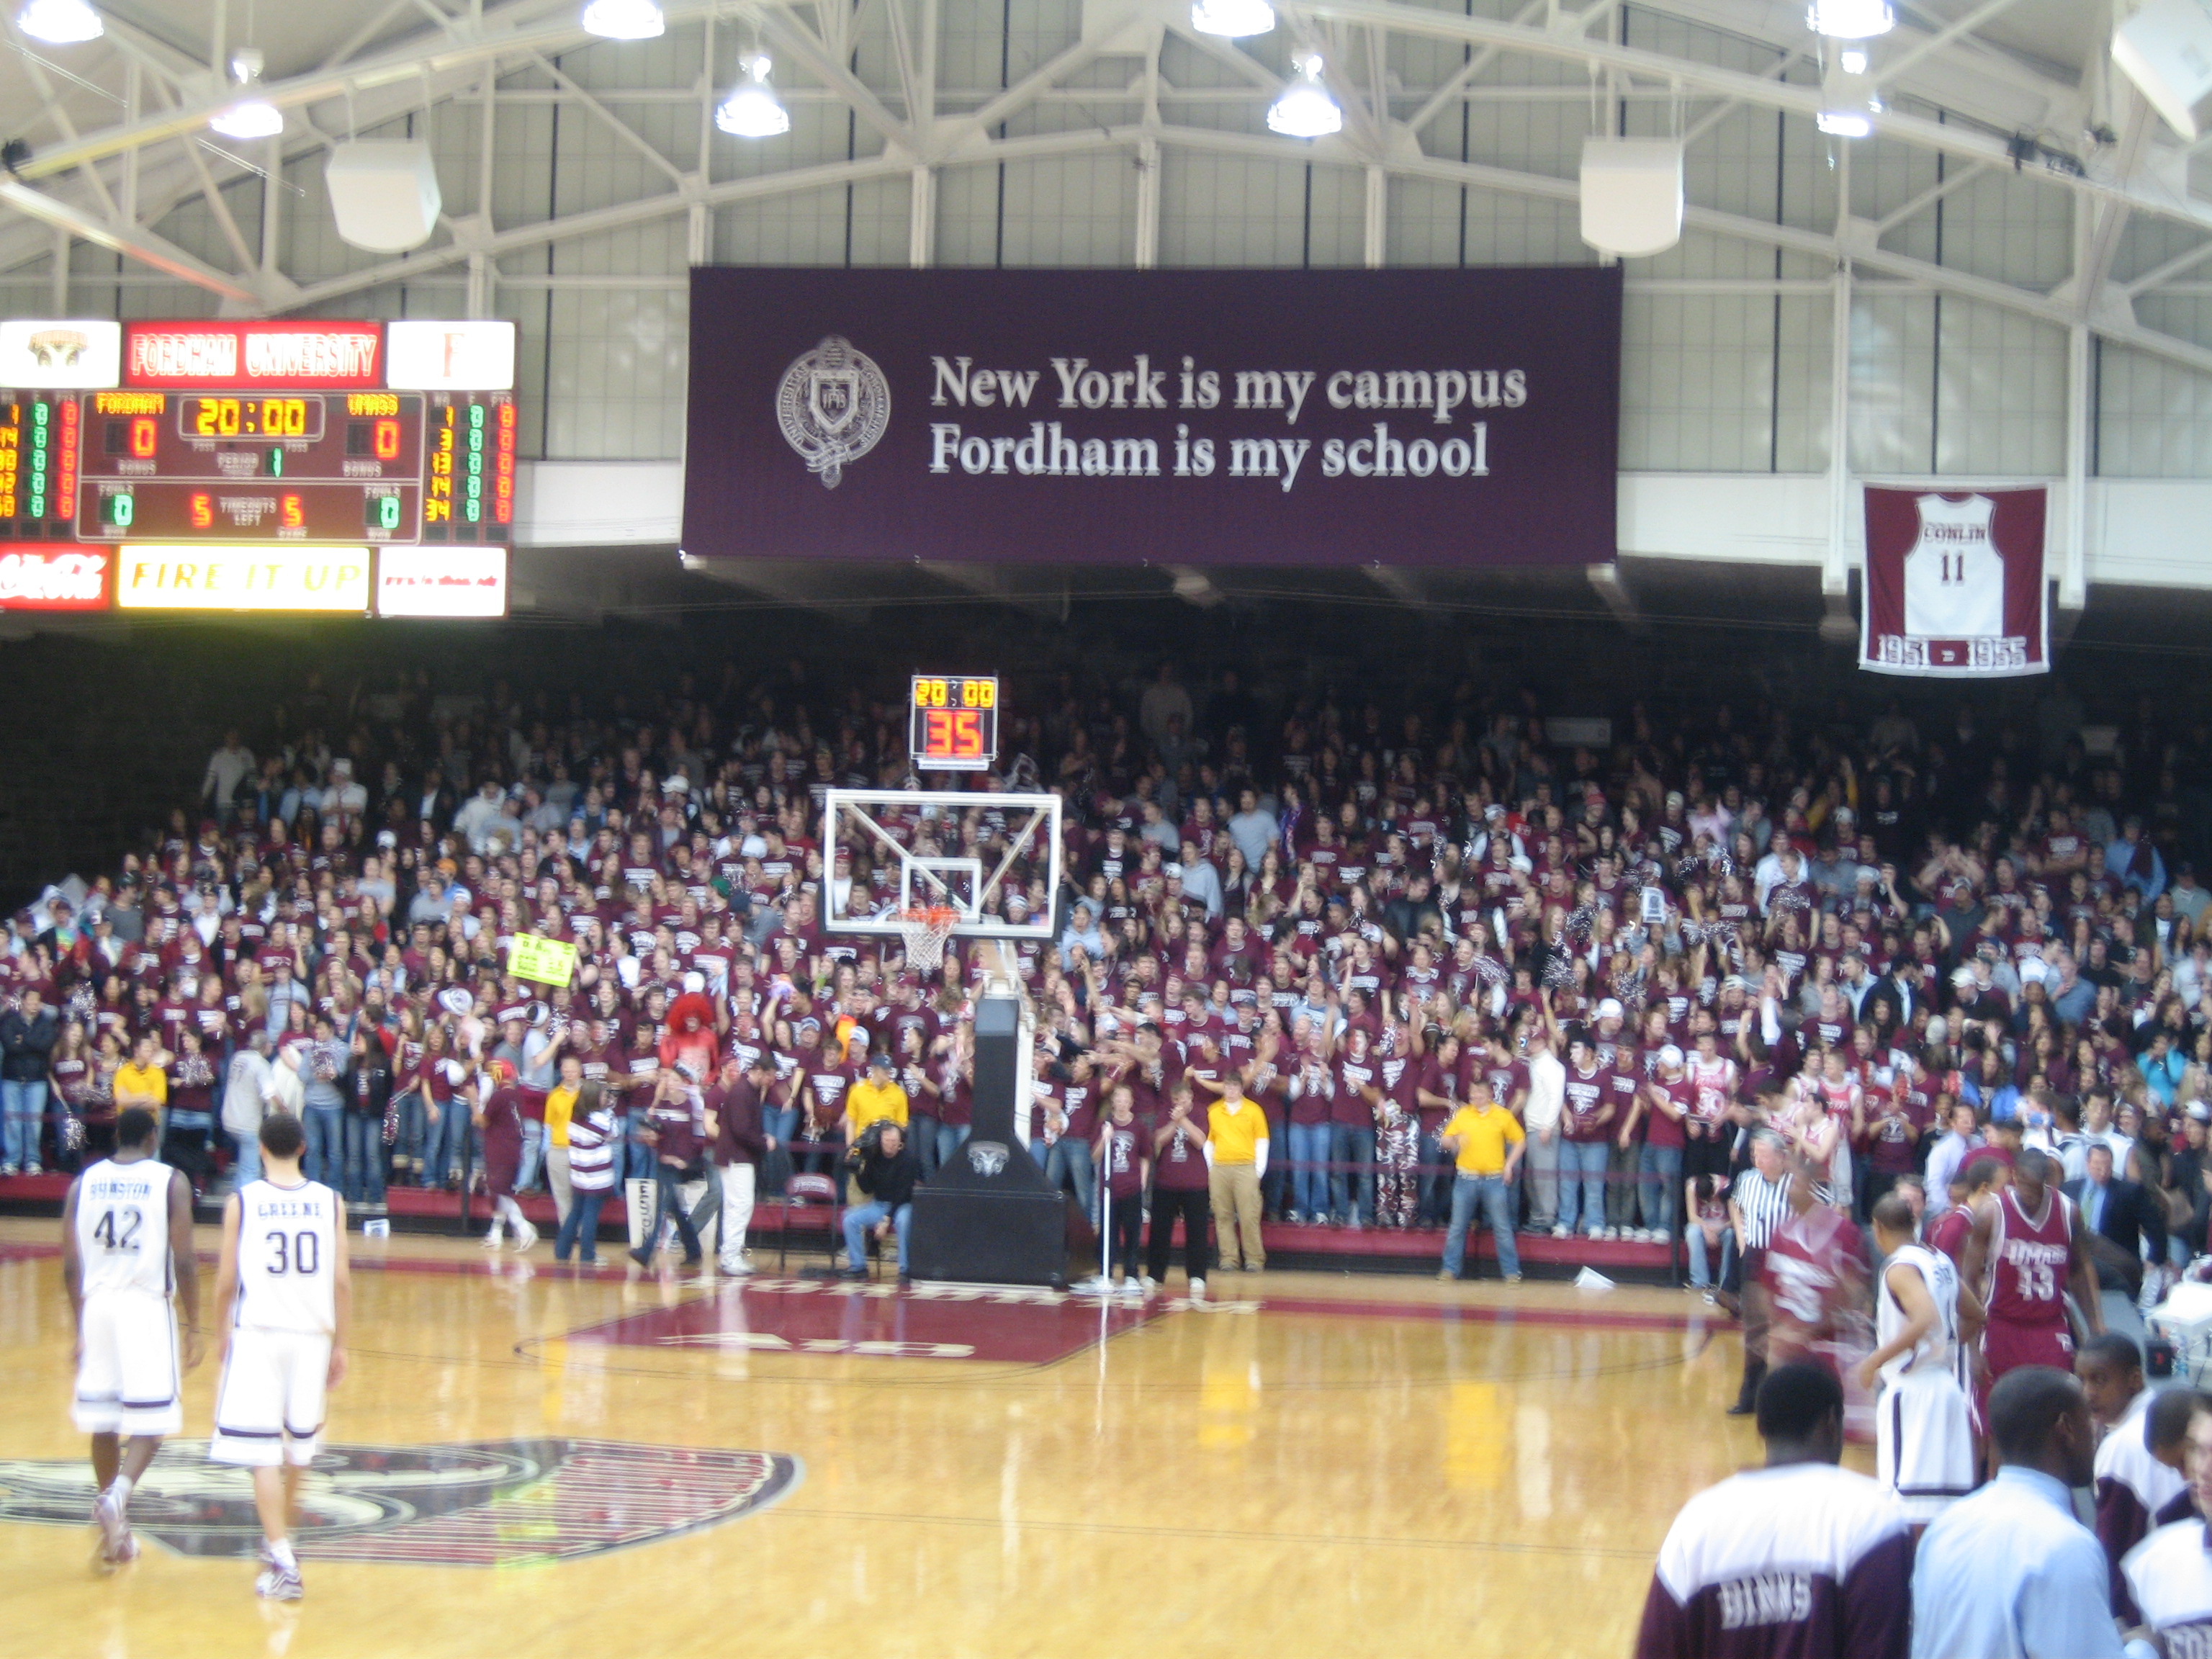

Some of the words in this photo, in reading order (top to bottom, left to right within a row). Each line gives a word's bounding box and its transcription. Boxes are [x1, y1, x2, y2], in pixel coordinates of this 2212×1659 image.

[130, 333, 237, 377] FORDHAM
[246, 333, 377, 377] UNIVERSITY
[95, 392, 166, 415] FORDHAM
[930, 355, 1040, 408] New
[1050, 354, 1168, 409] York
[1179, 355, 1221, 409] is
[1233, 371, 1316, 425] my
[1326, 369, 1527, 424] campus
[34, 403, 49, 426] 0
[63, 401, 78, 427] 0
[196, 397, 306, 437] 20:00
[346, 393, 399, 416] UMASS
[445, 405, 454, 428] 1
[469, 405, 484, 428] 0
[498, 403, 517, 428] 0
[33, 426, 48, 449] 0
[61, 426, 78, 450] 0
[132, 417, 157, 459] 0
[374, 419, 400, 460] 0
[439, 427, 453, 451] 3
[469, 428, 483, 452] 0
[497, 427, 516, 451] 0
[32, 448, 47, 472] 0
[60, 449, 77, 473] 0
[117, 459, 156, 476] BONUS
[272, 447, 283, 478] 1
[342, 461, 382, 477] BONUS
[431, 451, 452, 475] 13
[468, 451, 482, 475] 0
[496, 451, 515, 476] 0
[929, 421, 1161, 477] Fordham
[1173, 423, 1216, 477] is
[1228, 438, 1312, 493] my
[1321, 421, 1490, 477] school
[31, 472, 45, 495] 0
[58, 472, 76, 496] 0
[364, 485, 401, 498] FOULS
[431, 475, 452, 498] 14
[467, 475, 482, 499] 0
[495, 475, 513, 499] 0
[30, 495, 45, 518] 0
[58, 495, 75, 519] 0
[113, 493, 135, 527] 0
[190, 493, 214, 529] 5
[219, 497, 277, 514] TIMEOUTS
[232, 511, 261, 526] LEFT
[282, 493, 305, 529] 5
[379, 495, 401, 529] 0
[425, 498, 451, 522] 34
[465, 498, 480, 522] 0
[495, 498, 513, 523] 0
[1923, 522, 1990, 544] CONLIN
[132, 562, 224, 590] FIRE
[246, 563, 282, 590] IT
[303, 565, 361, 591] UP
[1941, 550, 1964, 587] 11
[1877, 634, 1931, 670] 1951
[1966, 635, 2027, 672] 1955
[926, 709, 983, 758] 35
[258, 1200, 323, 1222] GREENE
[94, 1203, 143, 1256] 42
[265, 1228, 320, 1278] 30
[2006, 1238, 2067, 1266] UMASS
[2016, 1265, 2054, 1302] 13
[1717, 1570, 1812, 1630] BINNS
